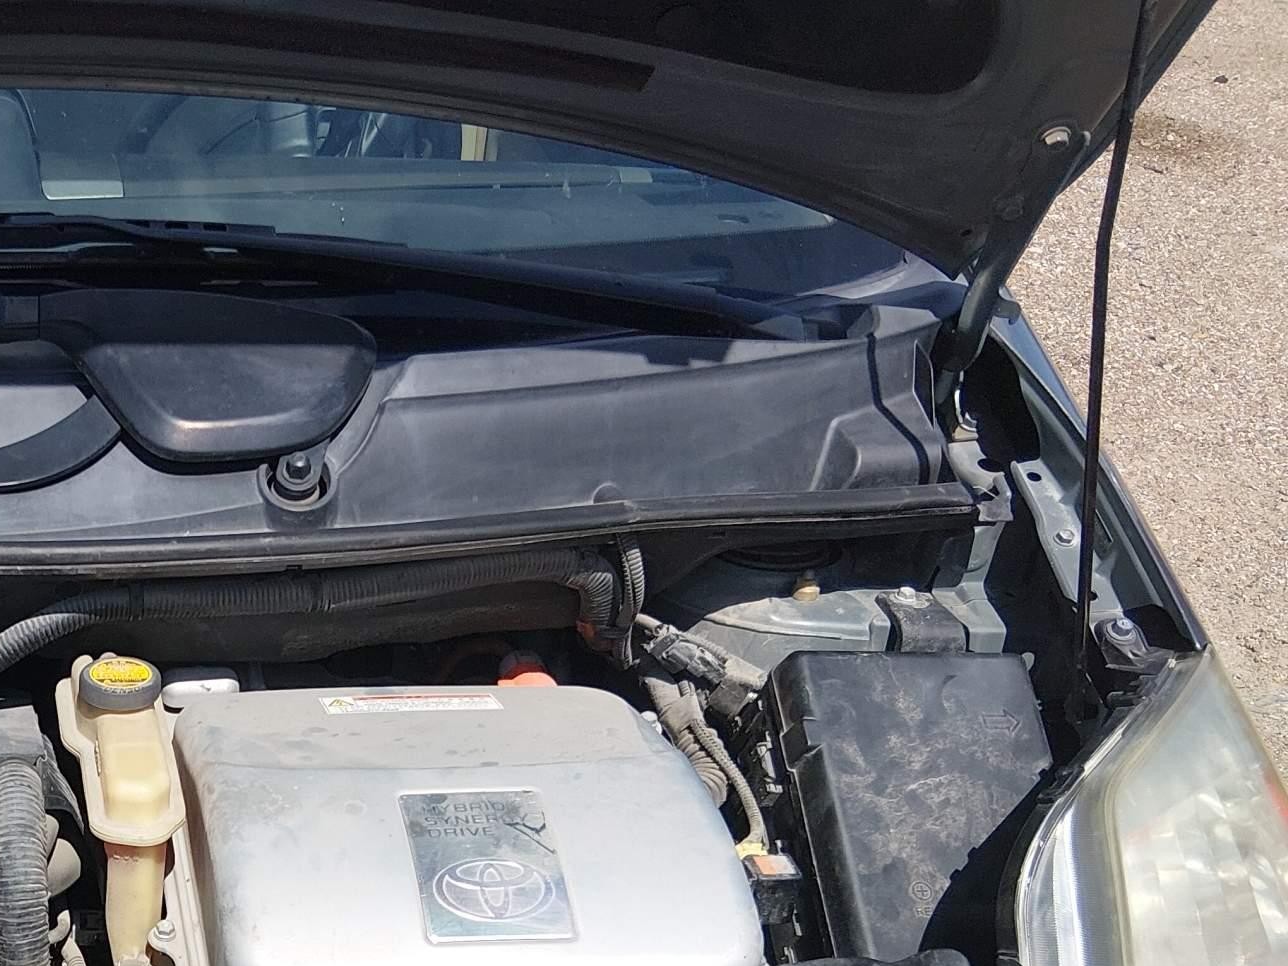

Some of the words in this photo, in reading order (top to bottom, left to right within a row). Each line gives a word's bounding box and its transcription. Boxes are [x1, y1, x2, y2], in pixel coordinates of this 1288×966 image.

[423, 801, 505, 814] HYBRID
[424, 814, 527, 825] SYNERGY
[428, 827, 495, 837] DRIVE
